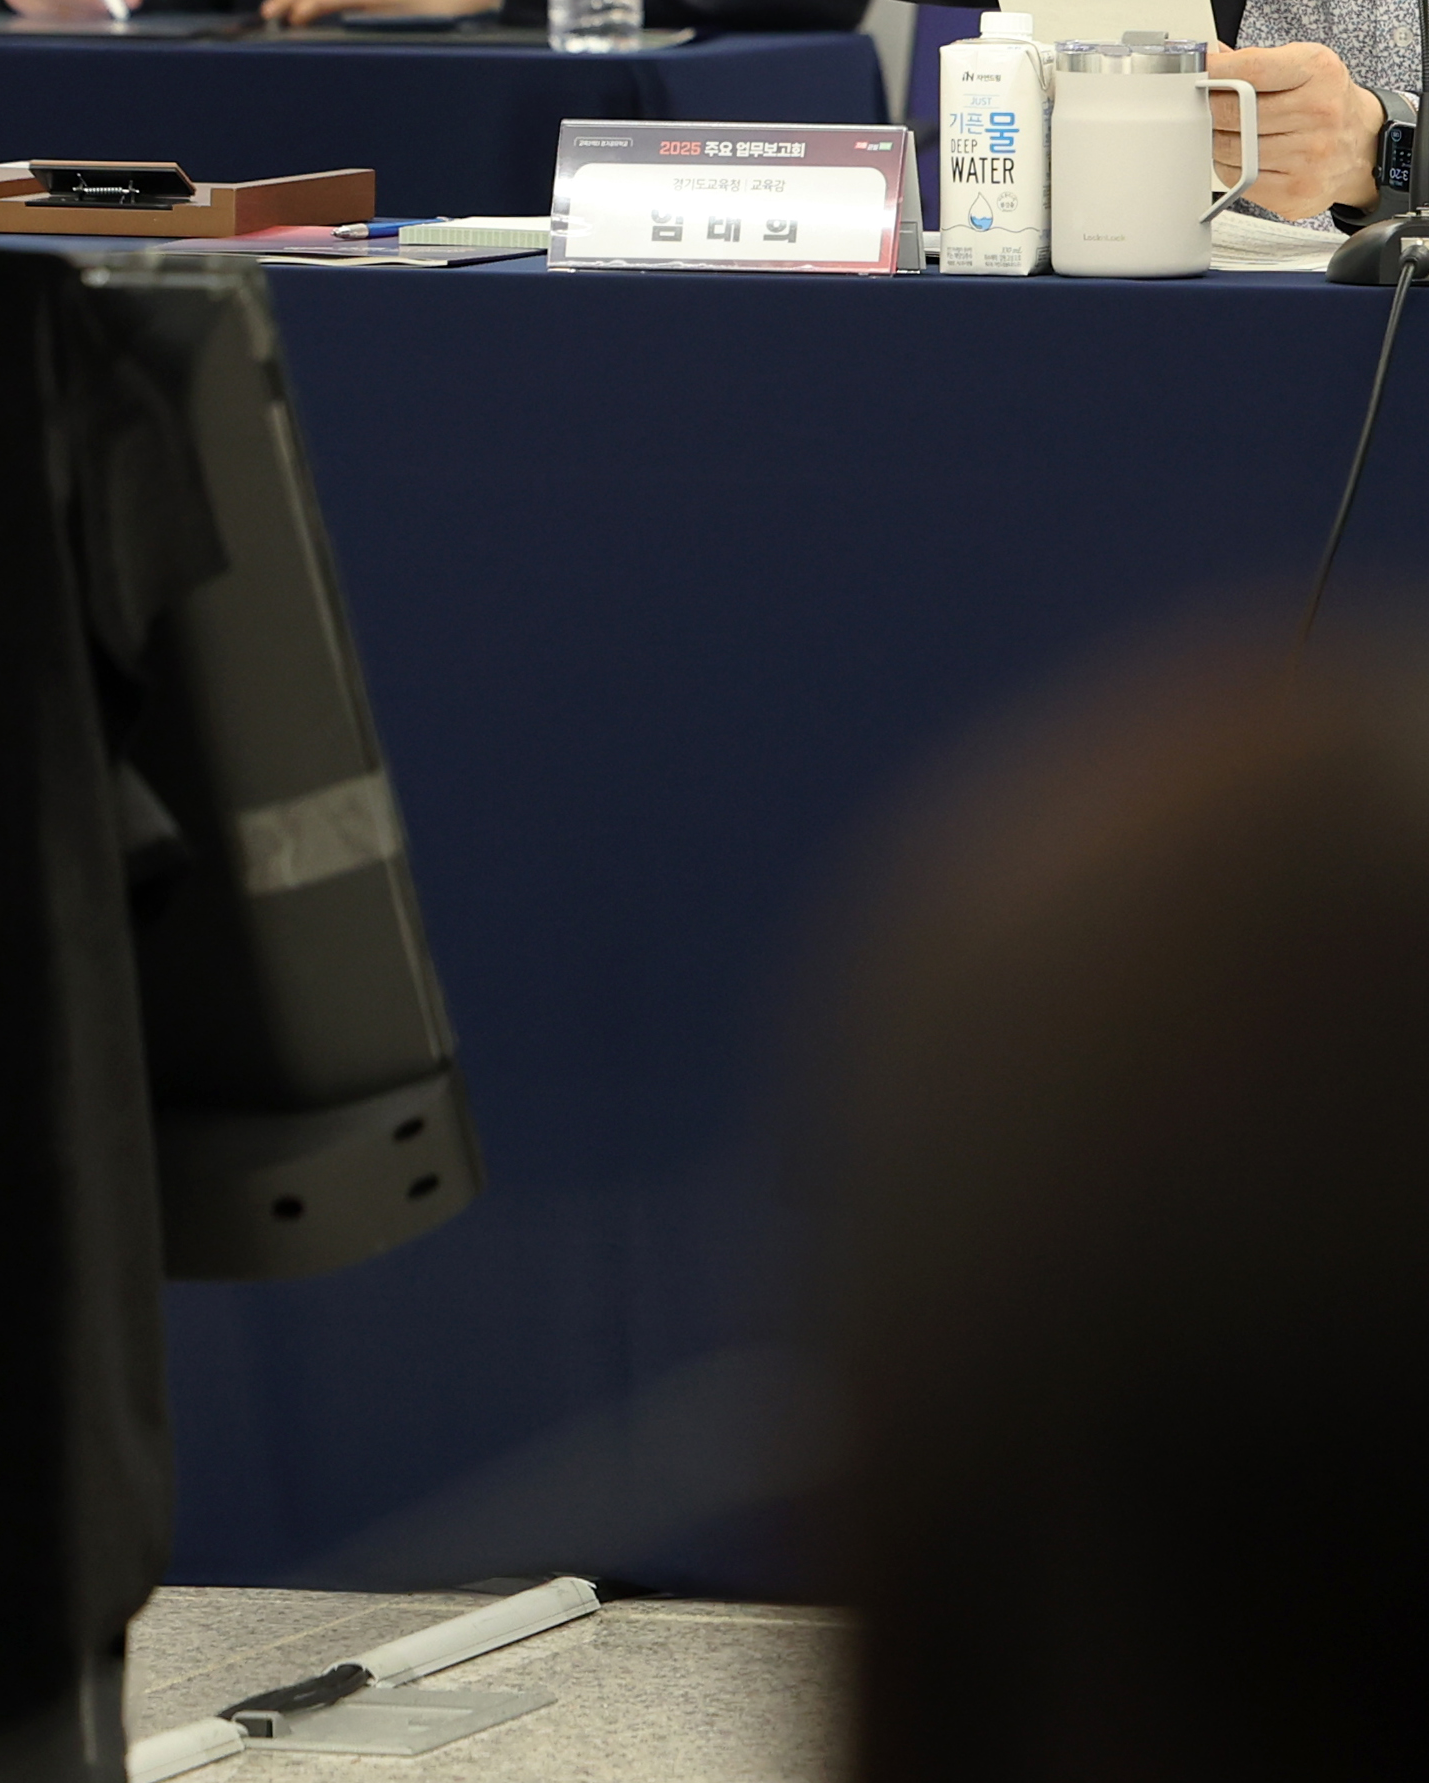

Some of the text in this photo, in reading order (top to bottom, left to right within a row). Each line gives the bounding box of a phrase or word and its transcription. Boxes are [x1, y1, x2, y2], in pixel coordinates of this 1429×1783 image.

[971, 96, 992, 106] JUST
[659, 140, 806, 158] 2025 주요 업무보고회
[950, 138, 978, 154] DEEP
[951, 156, 1015, 184] WATER
[750, 178, 787, 193] 교육감
